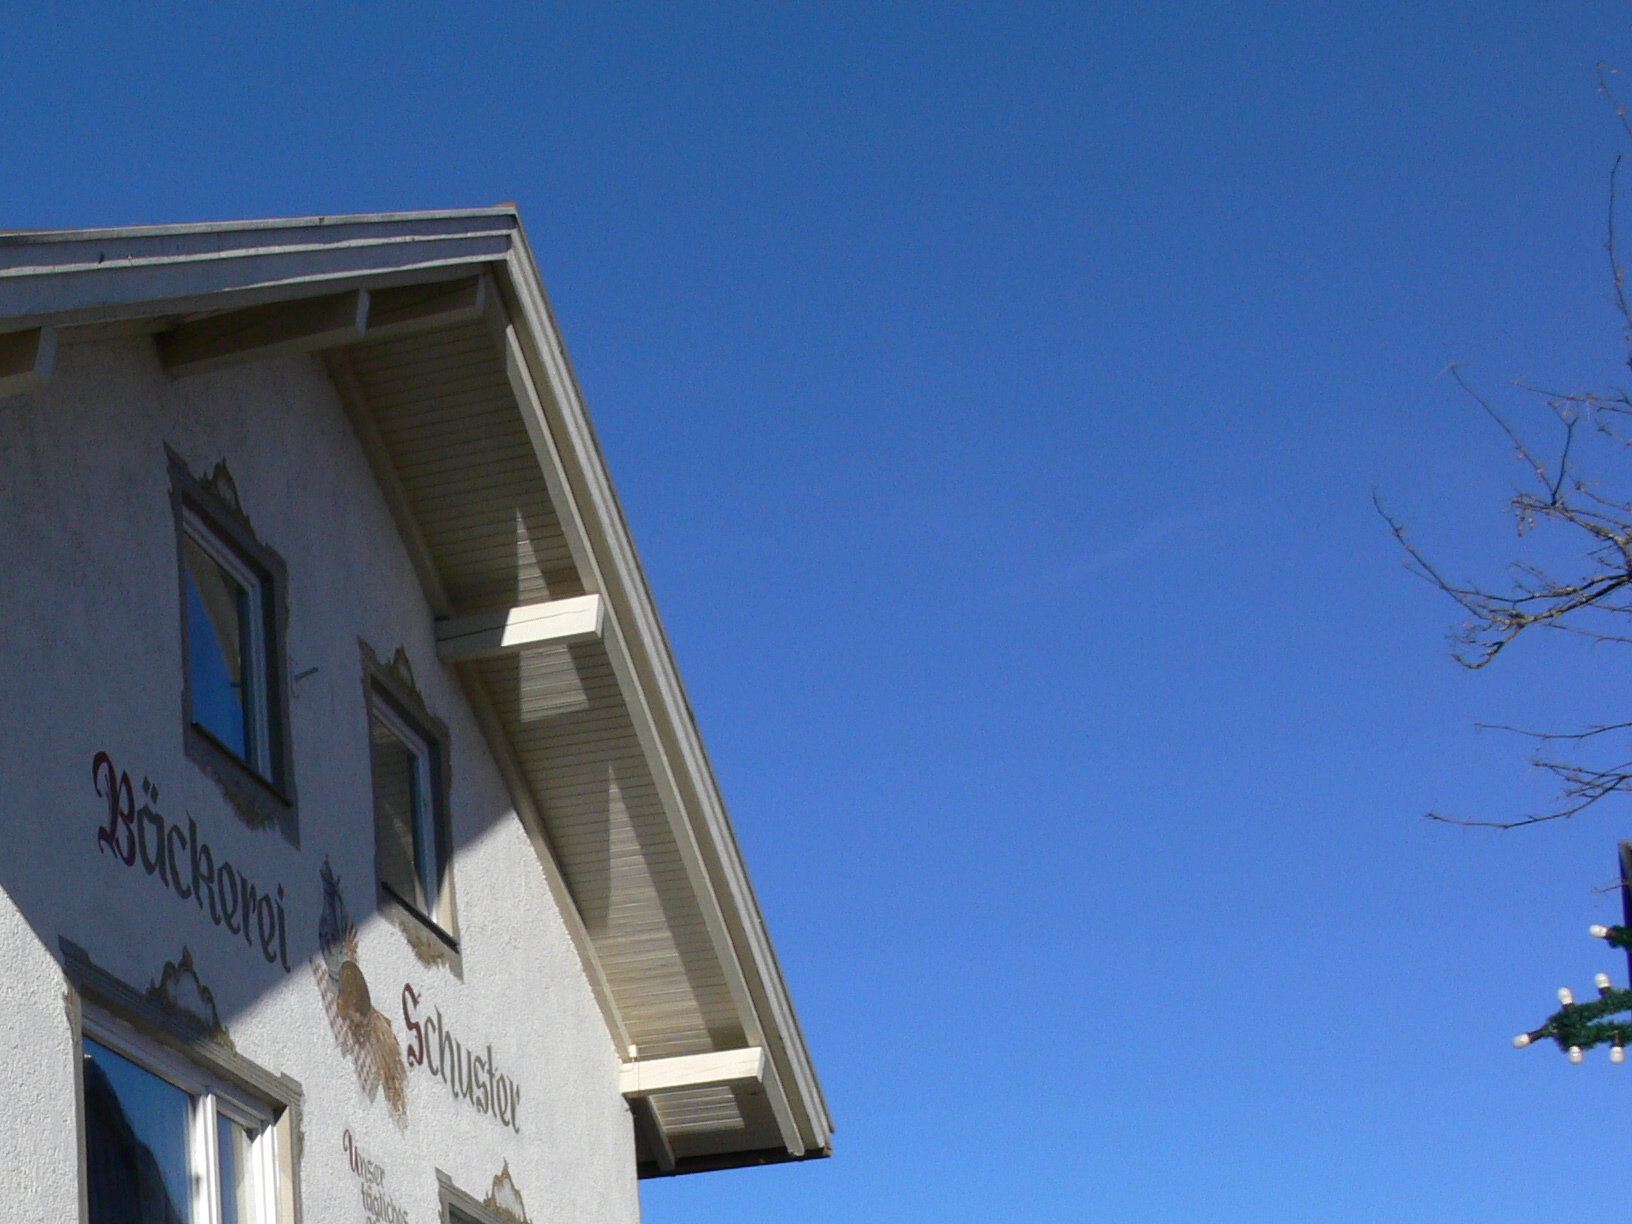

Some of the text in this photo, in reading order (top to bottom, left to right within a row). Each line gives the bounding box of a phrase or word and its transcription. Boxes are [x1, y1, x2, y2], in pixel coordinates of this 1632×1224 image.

[92, 751, 520, 1133] Bäckerei Schuster
[343, 1129, 385, 1188] Unser
